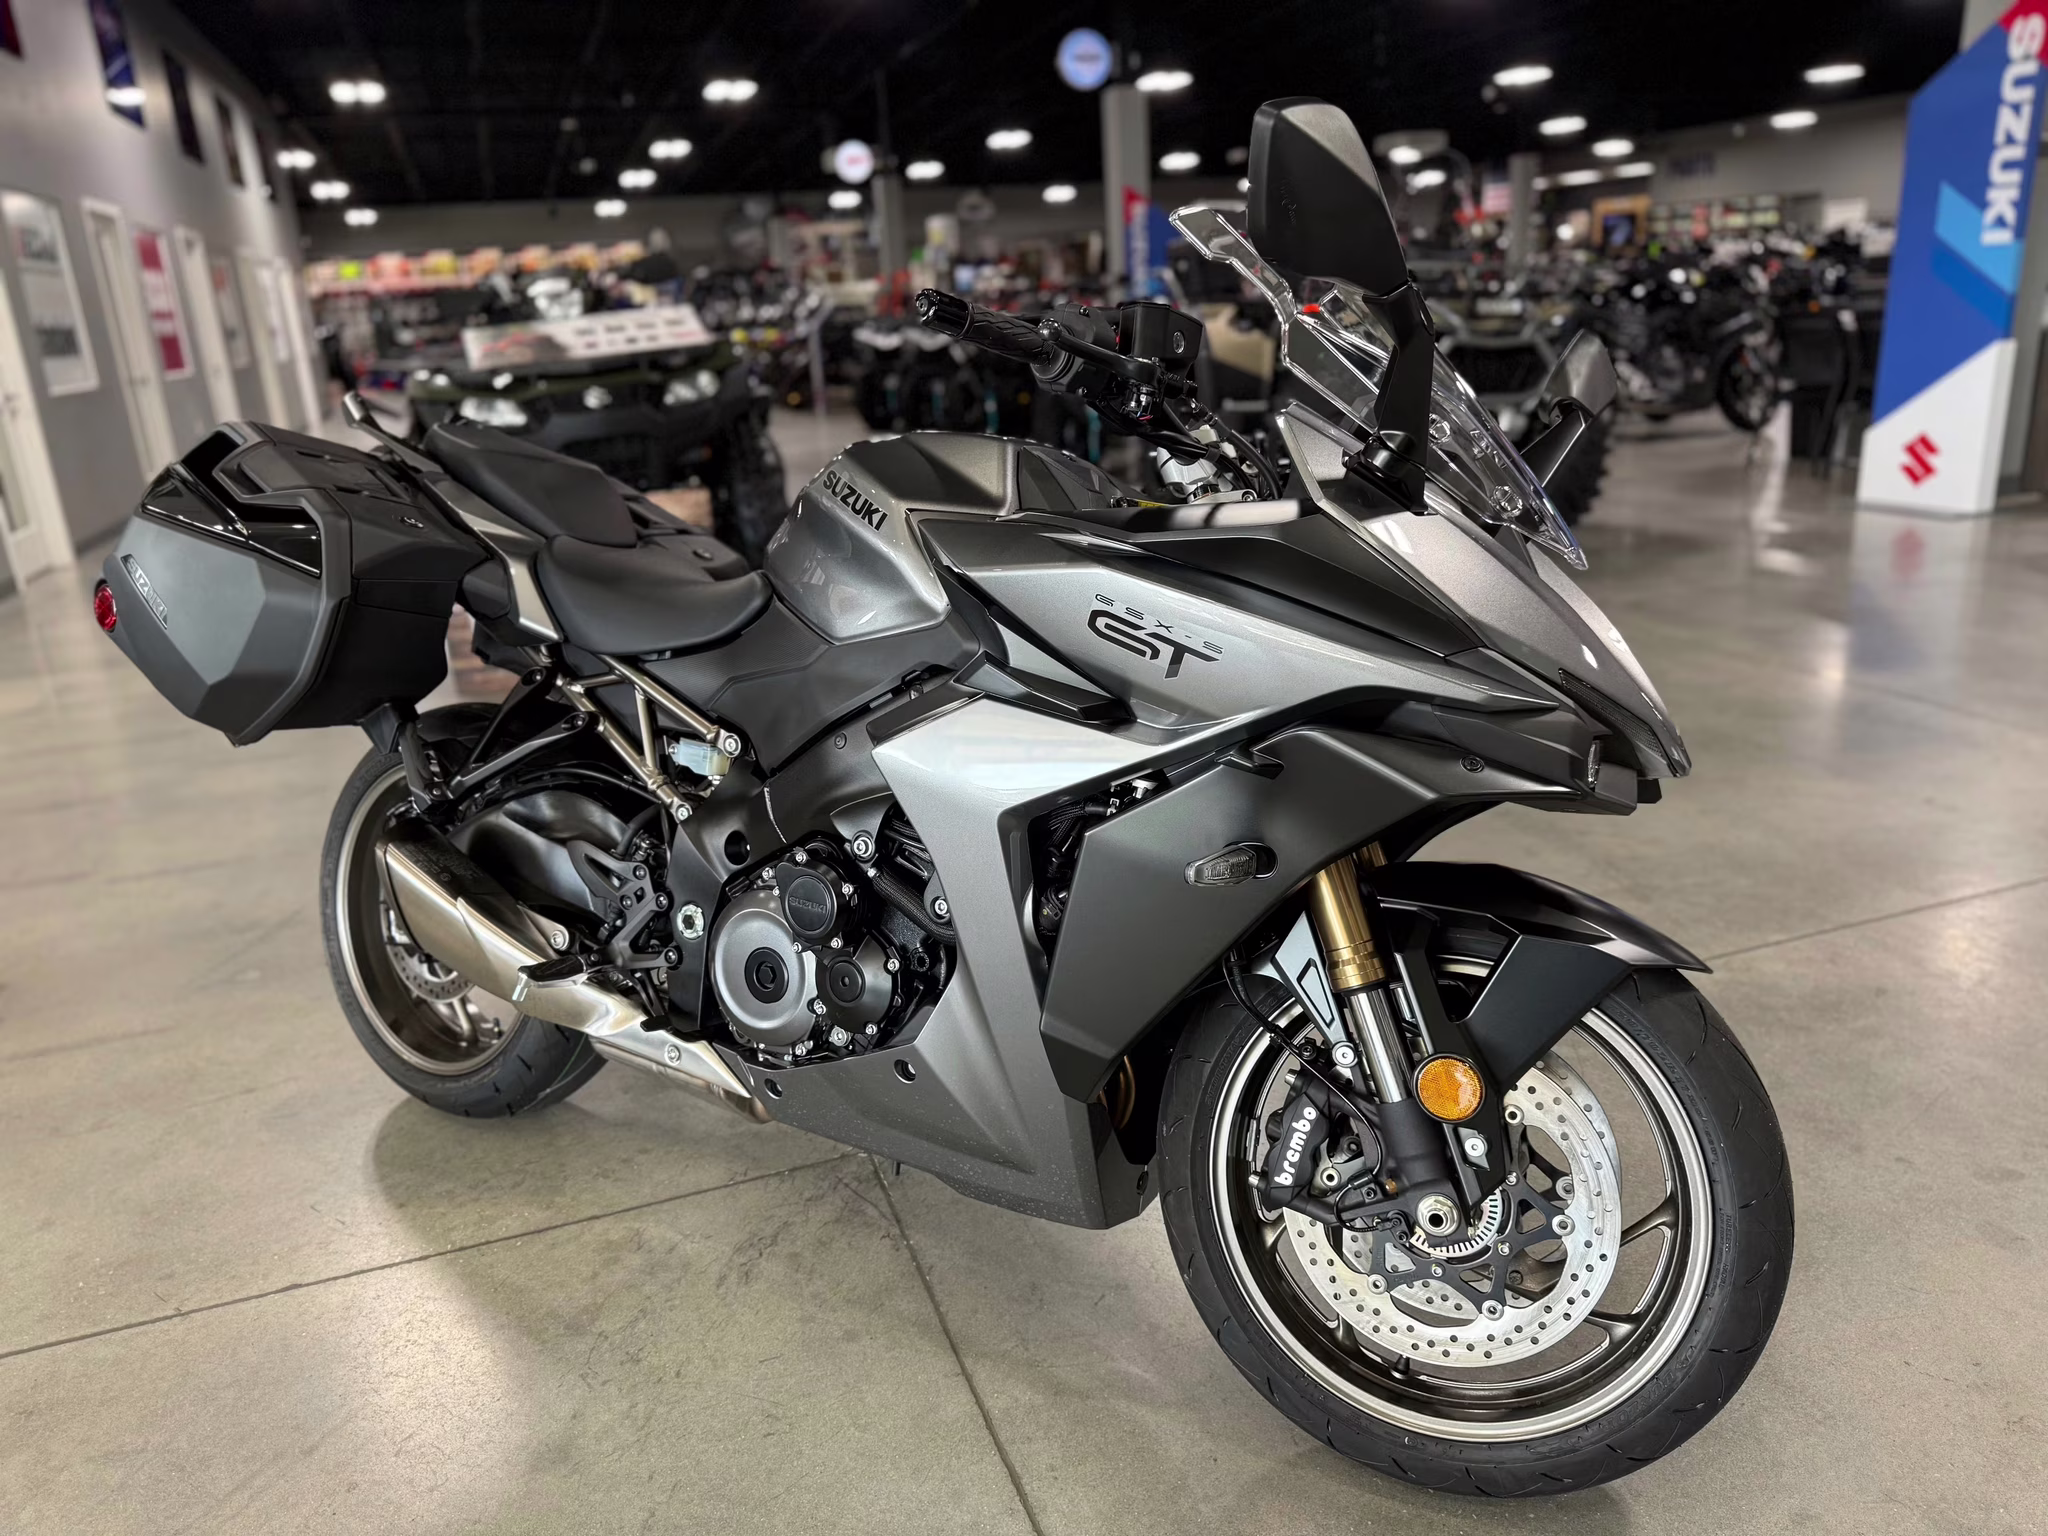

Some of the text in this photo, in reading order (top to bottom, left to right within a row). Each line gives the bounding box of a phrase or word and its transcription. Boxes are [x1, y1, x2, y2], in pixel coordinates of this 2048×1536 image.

[1980, 12, 2046, 246] SUZUKI
[823, 469, 888, 531] SUZUKI
[788, 896, 827, 914] SUZUKI
[1273, 1106, 1317, 1186] brembo
